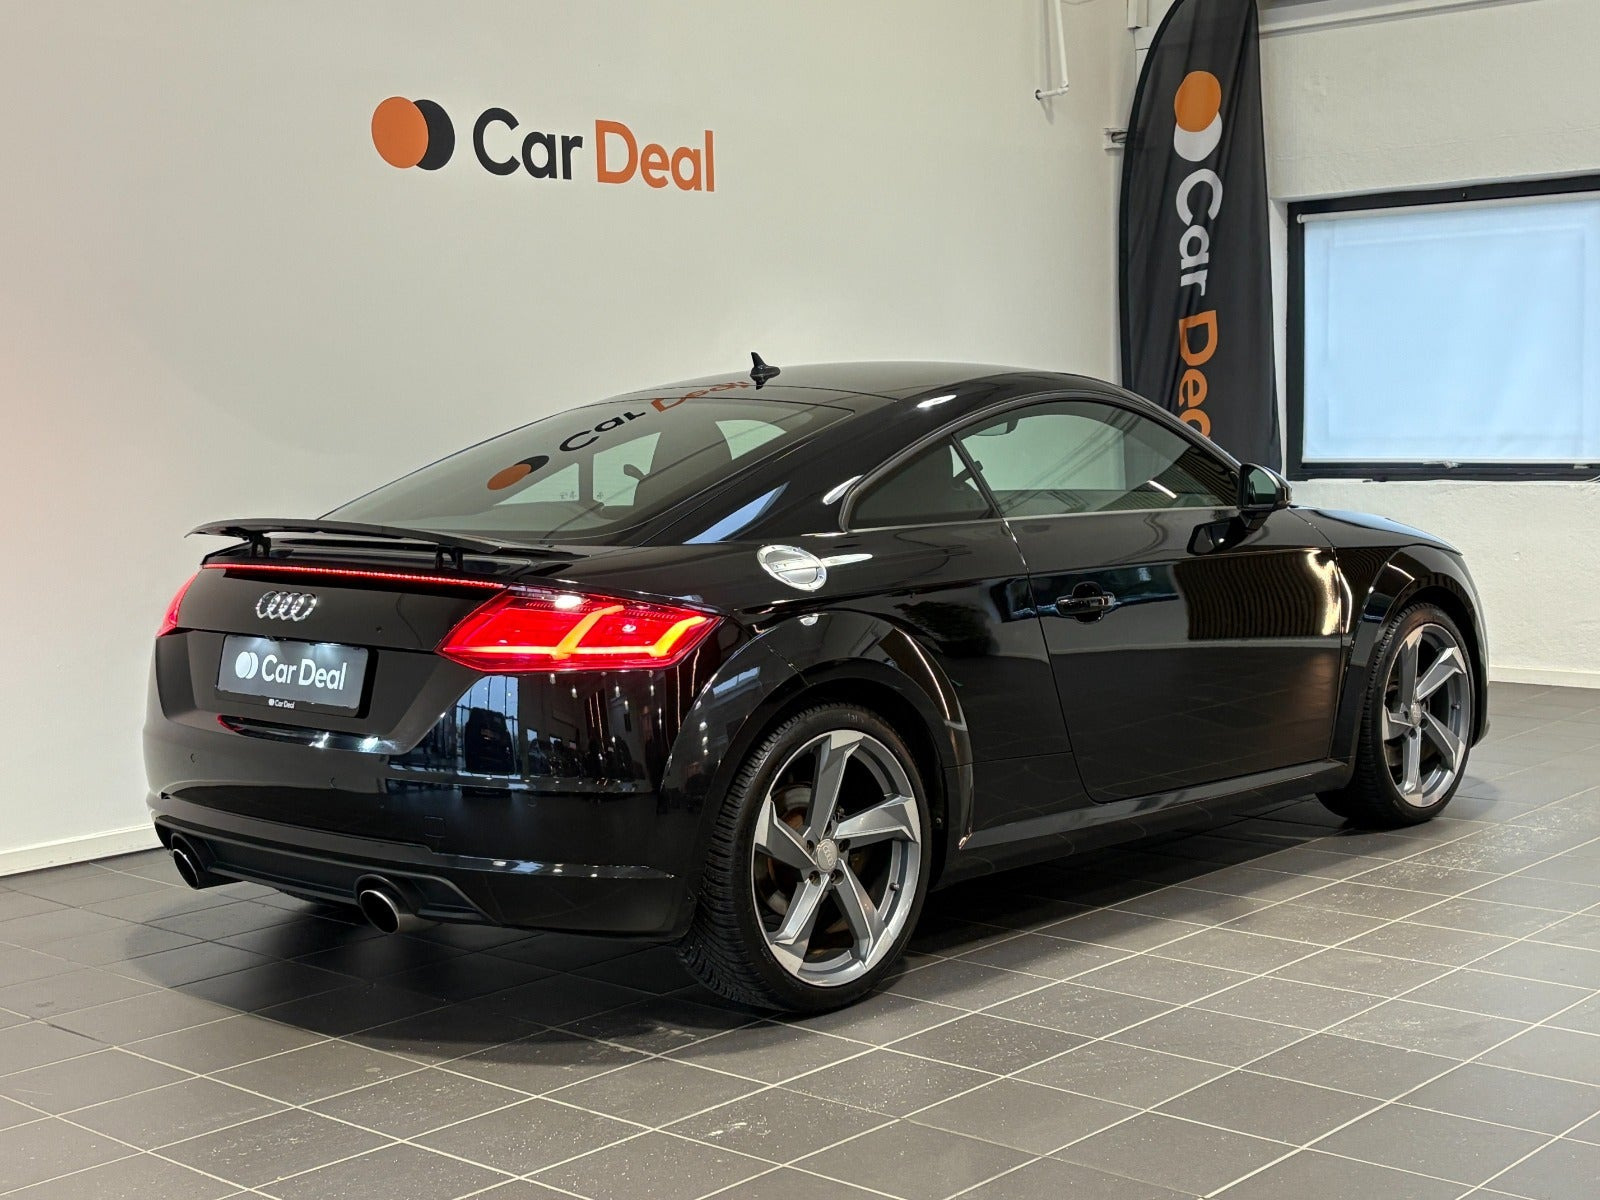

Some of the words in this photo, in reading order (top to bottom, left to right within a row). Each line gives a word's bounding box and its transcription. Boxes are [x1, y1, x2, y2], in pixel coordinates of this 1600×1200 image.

[473, 107, 583, 180] Car
[595, 119, 715, 192] Deal
[1175, 168, 1223, 296] Car
[1178, 309, 1218, 440] De
[261, 655, 297, 683] Car
[298, 658, 347, 690] Deal
[275, 699, 283, 707] Car
[284, 700, 295, 708] Deal
